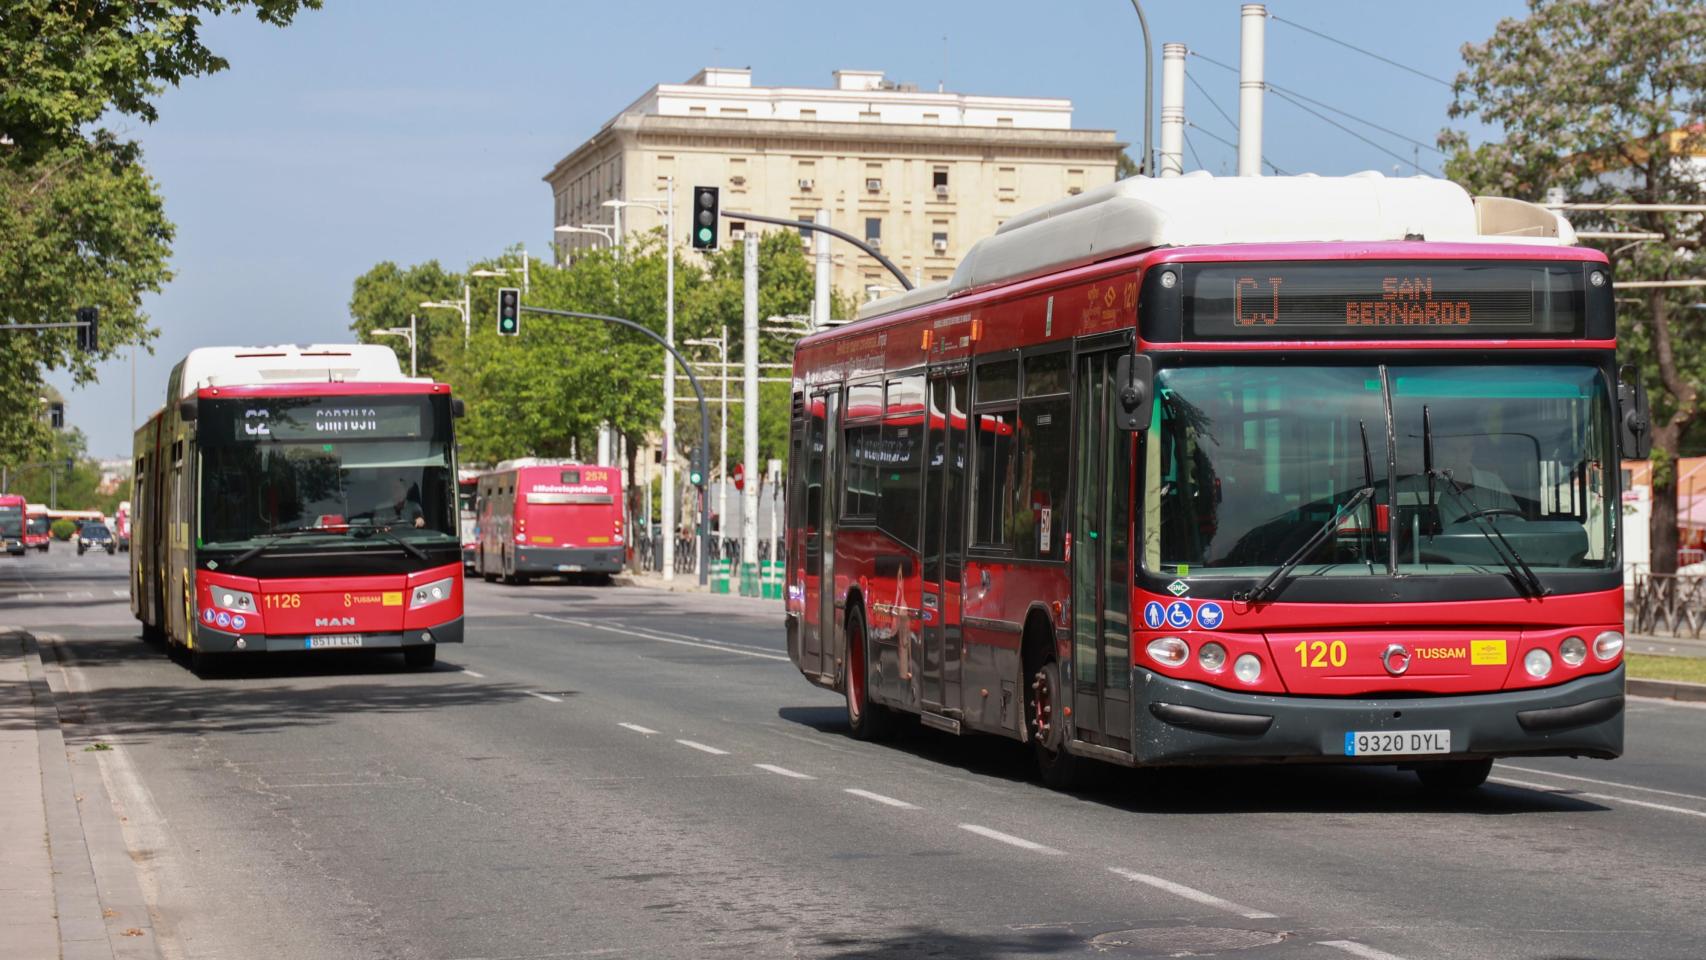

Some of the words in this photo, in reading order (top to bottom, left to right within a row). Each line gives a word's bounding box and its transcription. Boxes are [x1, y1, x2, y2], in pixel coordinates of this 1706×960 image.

[1382, 277, 1432, 300] SAN
[1346, 302, 1471, 325] BERNARDO
[245, 409, 270, 435] C2
[264, 593, 301, 609] 1126
[315, 617, 356, 627] MAN
[1294, 640, 1348, 668] 120
[1415, 648, 1466, 659] TUSSAM
[1358, 735, 1404, 751] 9320
[1411, 734, 1445, 750] DYL
